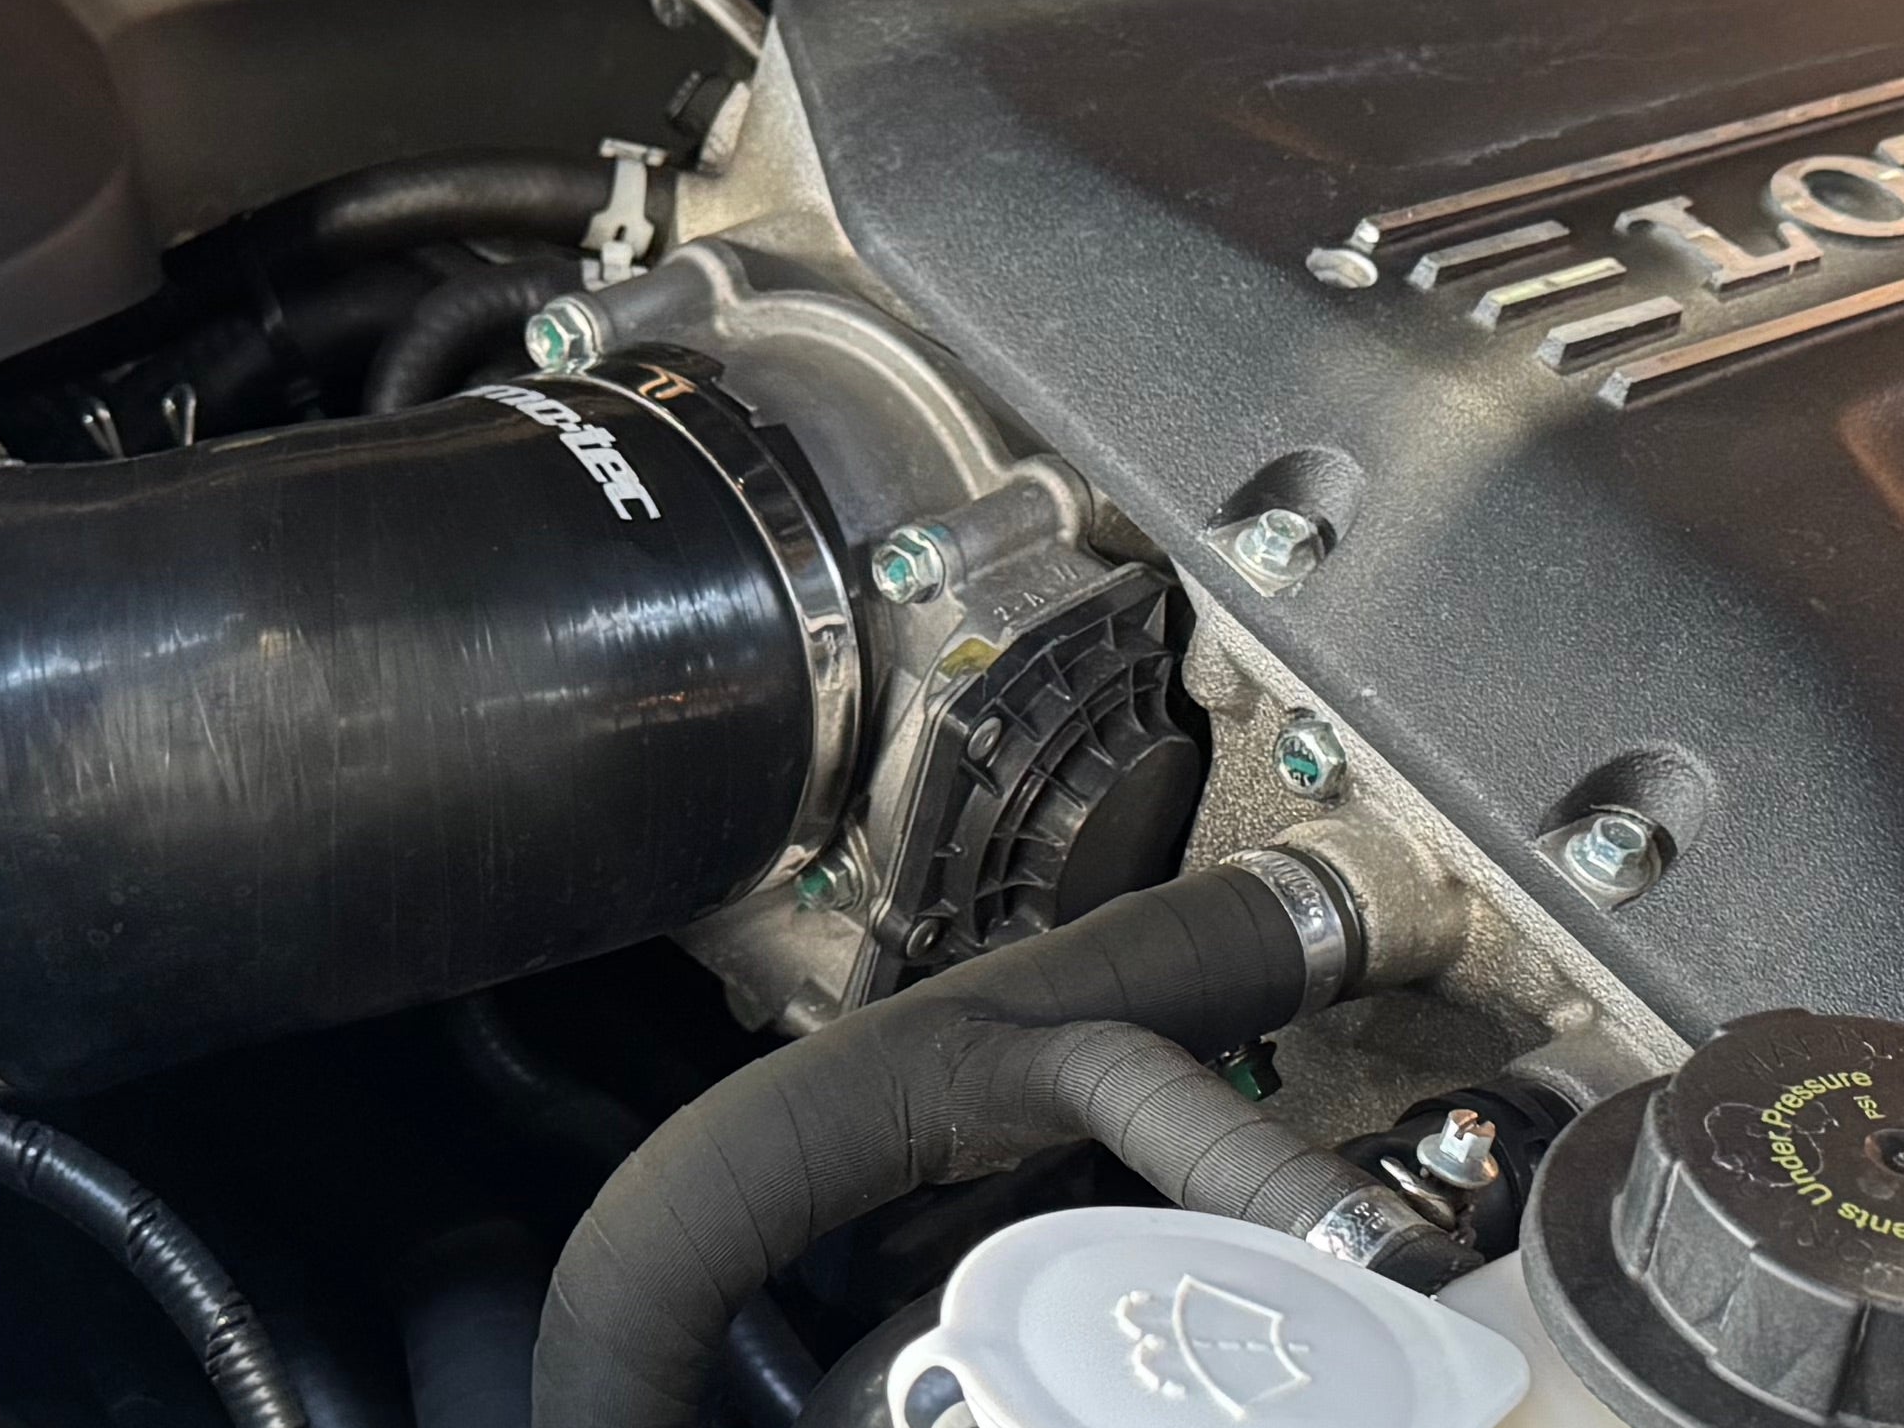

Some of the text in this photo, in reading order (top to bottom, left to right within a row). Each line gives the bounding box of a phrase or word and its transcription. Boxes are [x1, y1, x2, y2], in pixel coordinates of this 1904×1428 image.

[1760, 1070, 1874, 1129] Pressure
[1853, 1094, 1887, 1121] PSI
[1768, 1130, 1834, 1206] Under
